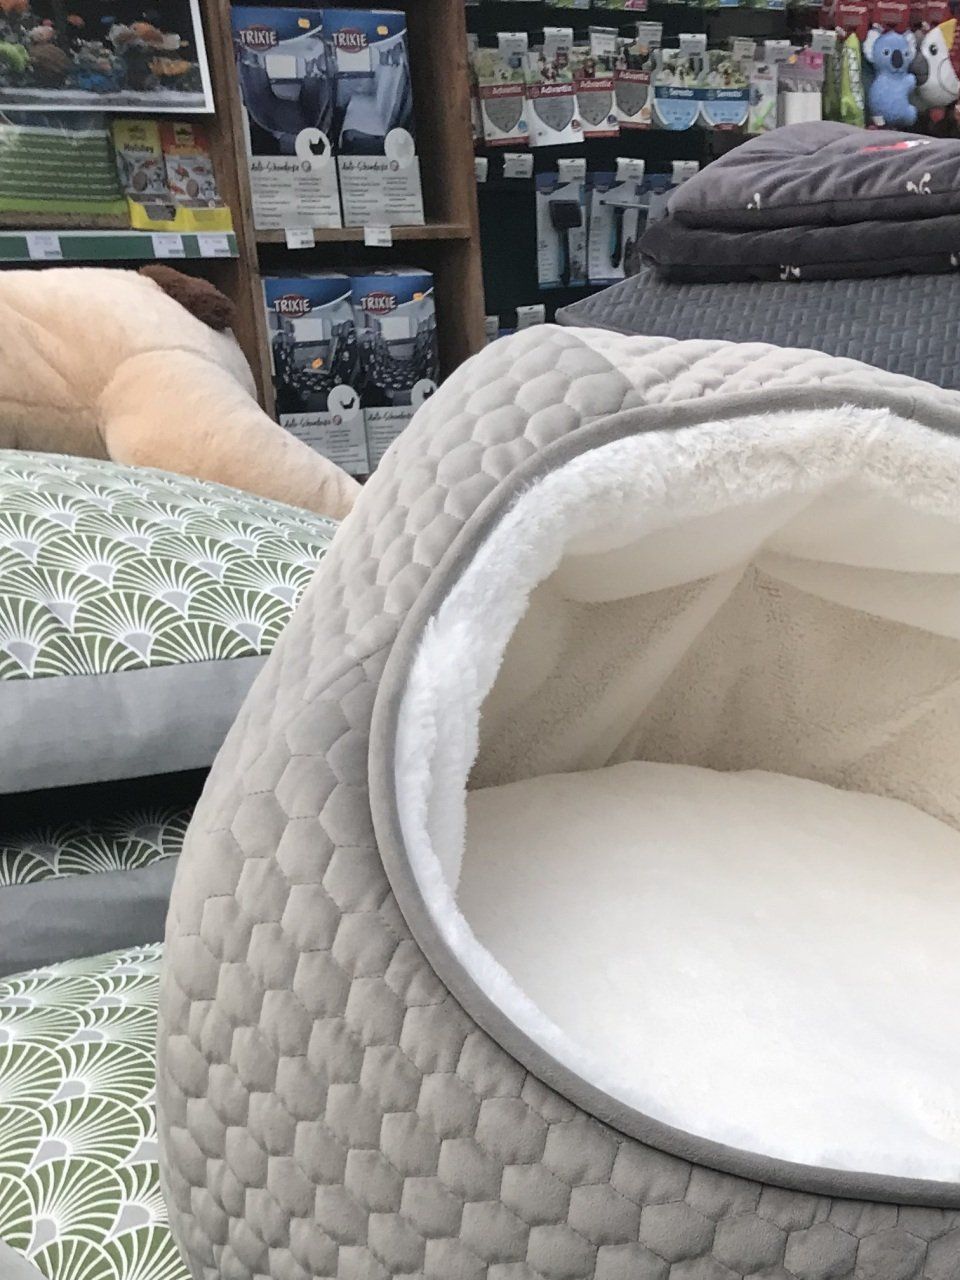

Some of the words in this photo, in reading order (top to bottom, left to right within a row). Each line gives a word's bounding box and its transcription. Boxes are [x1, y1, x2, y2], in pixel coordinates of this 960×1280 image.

[239, 30, 278, 45] TRIXIE
[332, 33, 368, 47] TRIXIE
[274, 299, 311, 313] TRIXIE
[360, 296, 397, 309] TRIXIE
